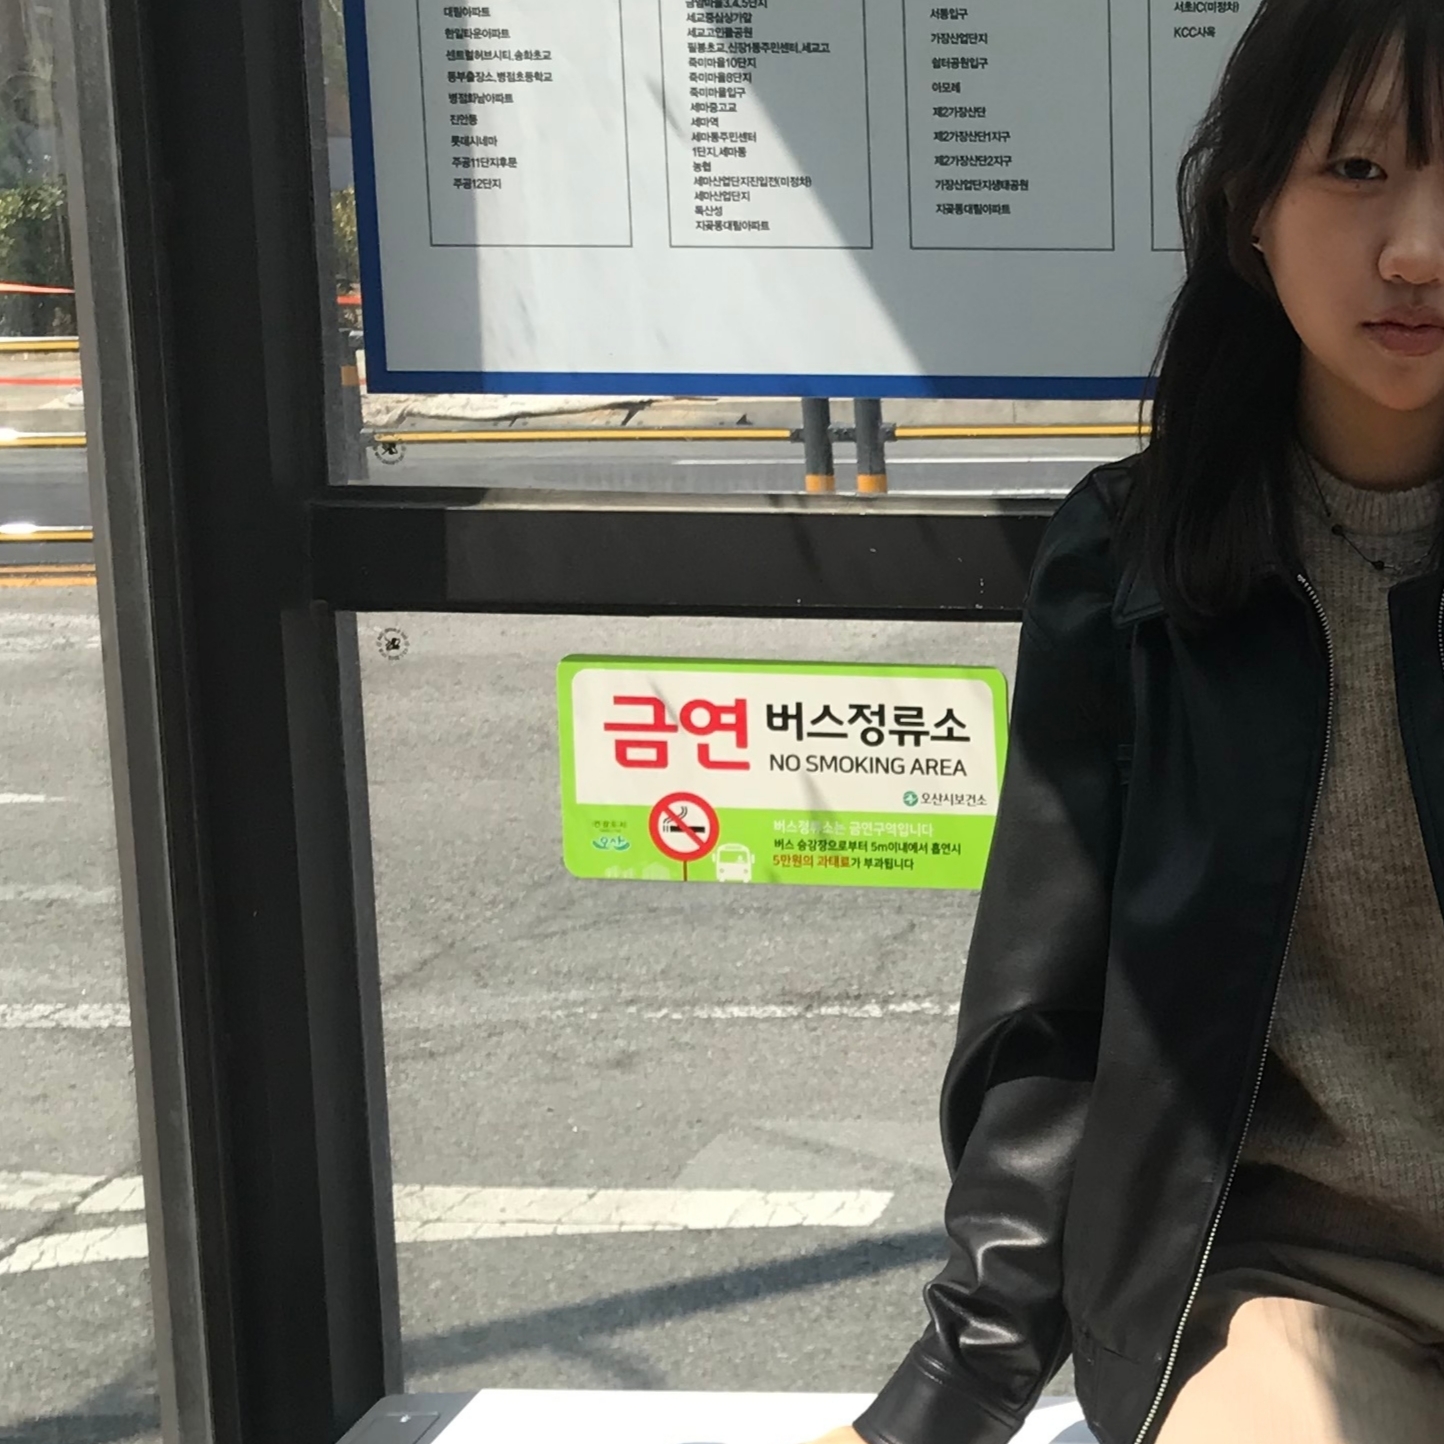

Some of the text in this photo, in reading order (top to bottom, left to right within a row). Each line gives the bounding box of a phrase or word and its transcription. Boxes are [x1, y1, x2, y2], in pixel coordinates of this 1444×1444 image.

[931, 33, 988, 45] 가장산업단지
[932, 82, 960, 93] 아모레
[451, 135, 498, 147] 롯데시네마
[452, 157, 518, 168] 주공11단지후문
[453, 178, 501, 189] 주공12단지
[694, 191, 750, 202] 세마산업단지
[766, 702, 970, 747] 버스정류소
[604, 696, 750, 770] 금연
[770, 754, 967, 777] NO SMOKING AREA
[921, 793, 988, 807] 오산시보건소
[850, 821, 934, 837] 금연구역입니다
[774, 838, 961, 855] 버스 승강장으로부터 5m이내에서 흡연시
[773, 854, 914, 870] 5만원의 과태료가 부과됩니다
